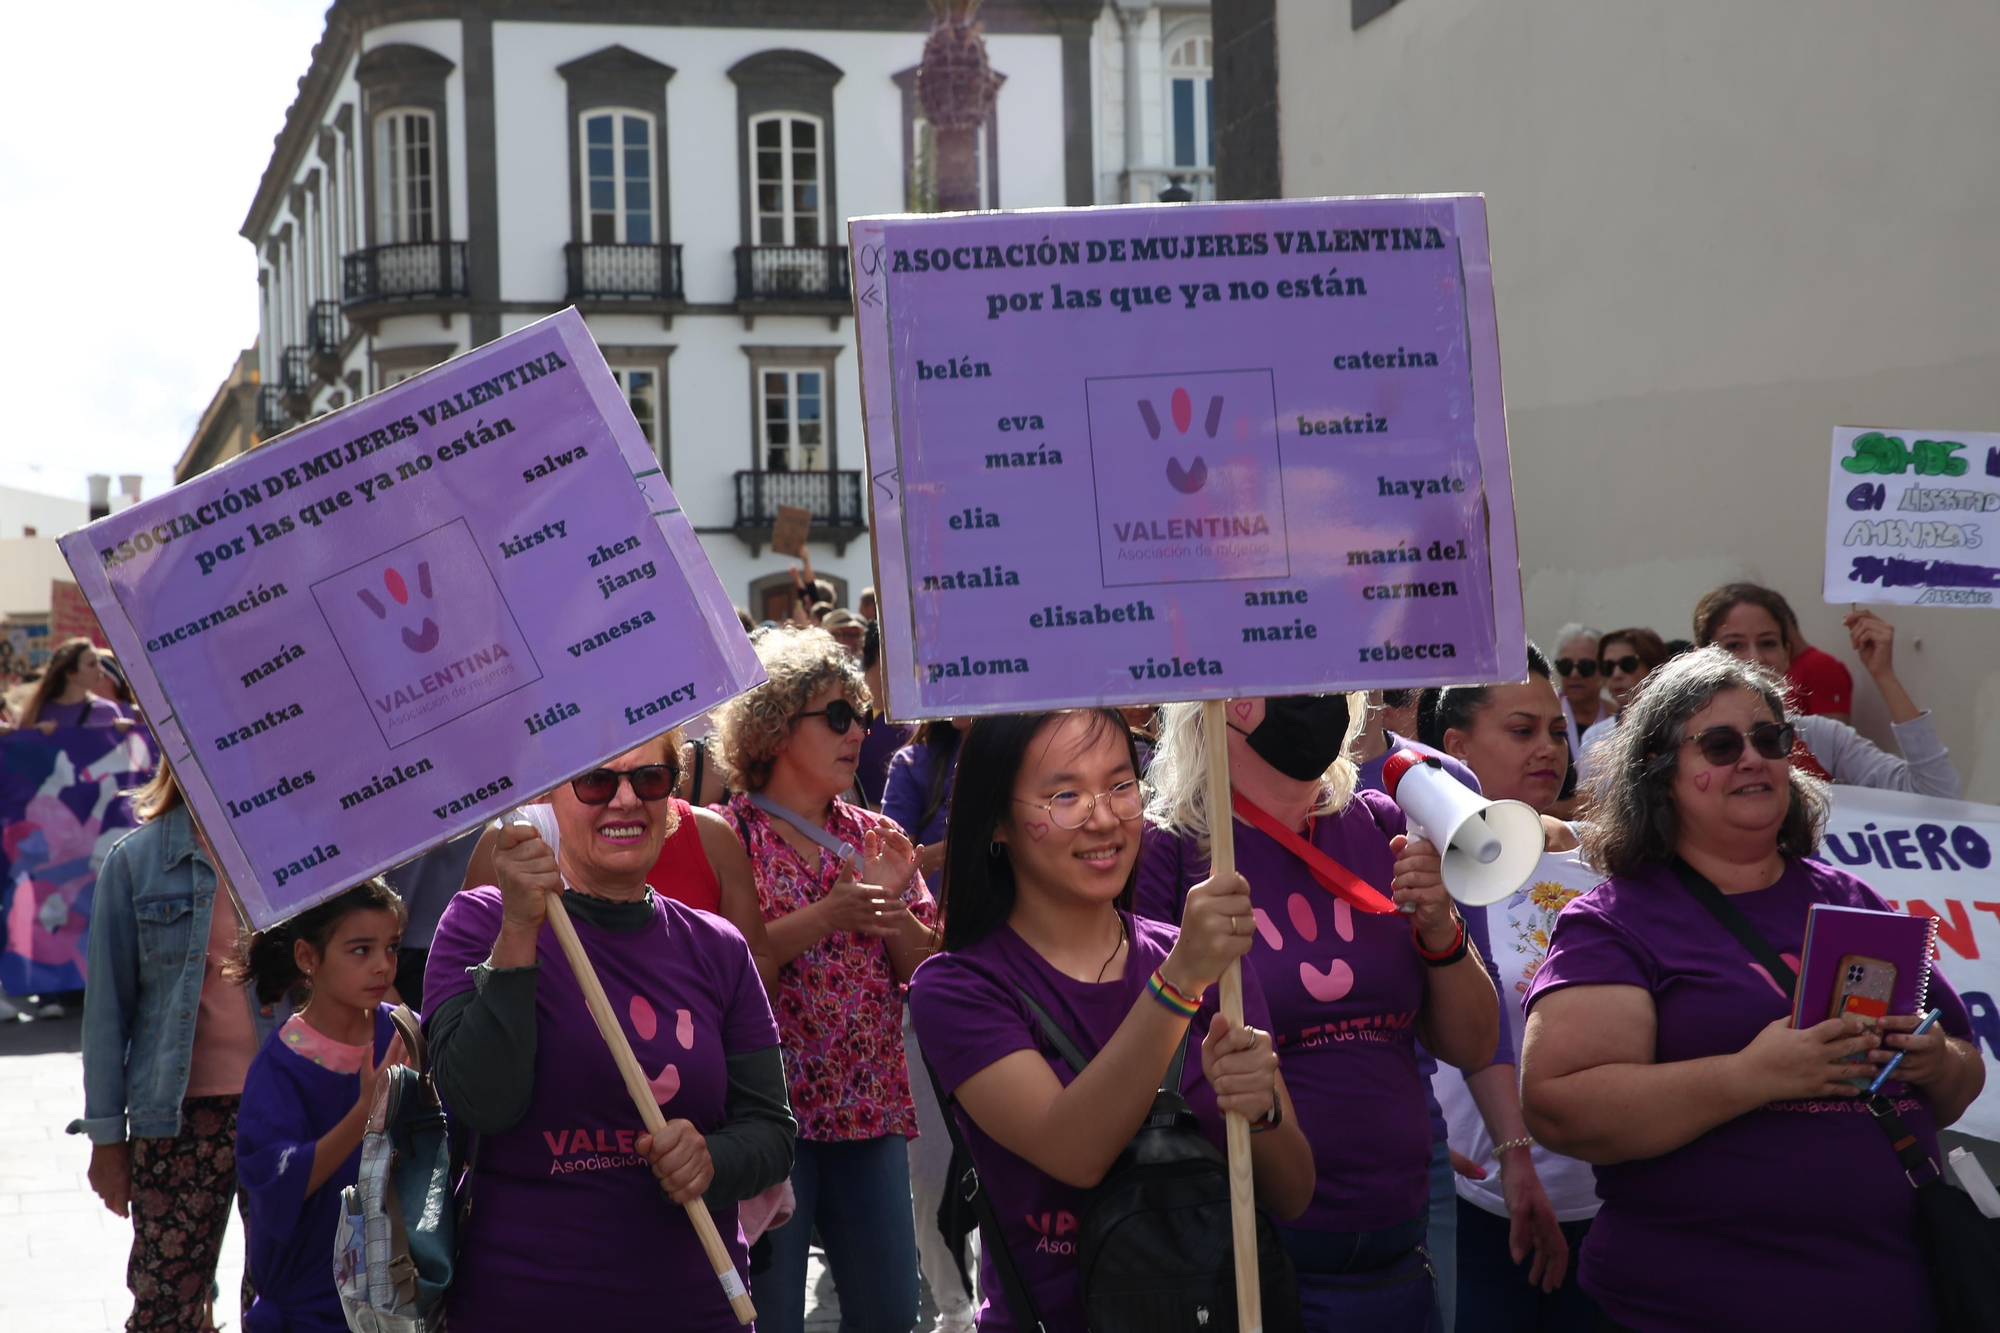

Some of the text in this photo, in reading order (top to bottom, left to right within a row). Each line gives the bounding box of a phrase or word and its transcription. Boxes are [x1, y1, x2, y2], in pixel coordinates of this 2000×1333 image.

[892, 235, 1079, 273] ASOCIACIÓN
[1086, 239, 1126, 263] DE
[1130, 233, 1268, 261] MUJERES
[1274, 227, 1445, 254] VALENTINA
[986, 267, 1367, 319] por las que ya no están
[916, 355, 991, 380] belén
[1334, 347, 1438, 370] caterina
[998, 415, 1044, 431] eva
[1297, 413, 1387, 435] beatriz
[100, 351, 567, 570] ASOCIACIÓN DE MUJERES VALENTINA
[523, 446, 588, 483] salwa
[985, 443, 1063, 468] maría
[195, 418, 515, 575] por las que ya no están
[1377, 475, 1465, 499] hayate
[949, 507, 1000, 530] elia
[1113, 515, 1270, 542] VALENTINA
[1843, 519, 1983, 549] AMENAZAS
[499, 520, 567, 559] kirsty
[588, 536, 641, 568] zhen
[1117, 545, 1191, 561] Asociación
[1196, 544, 1212, 557] de
[1347, 540, 1467, 566] maría del
[597, 561, 656, 600] jiang
[923, 566, 1019, 591] natalia
[1363, 581, 1458, 600] carmen
[1245, 590, 1307, 606] anne
[147, 583, 288, 652] encarnación
[1030, 601, 1154, 628] elisabeth
[1242, 619, 1317, 642] marie
[567, 611, 656, 657] vanessa
[241, 645, 305, 688] maría
[1359, 640, 1456, 662] rebecca
[375, 643, 509, 714] VALENTINA
[927, 656, 1029, 683] paloma
[1129, 657, 1223, 680] violeta
[388, 694, 450, 729] Asociación
[452, 685, 467, 699] de
[524, 703, 580, 735] lidia
[625, 682, 696, 725] francy
[215, 704, 303, 751] arantxa
[227, 770, 315, 818] lourdes
[339, 758, 433, 810] maialen
[433, 776, 513, 819] vanesa
[1811, 822, 1991, 871] UIERO
[273, 844, 340, 887] paula
[543, 1129, 648, 1156] VALE
